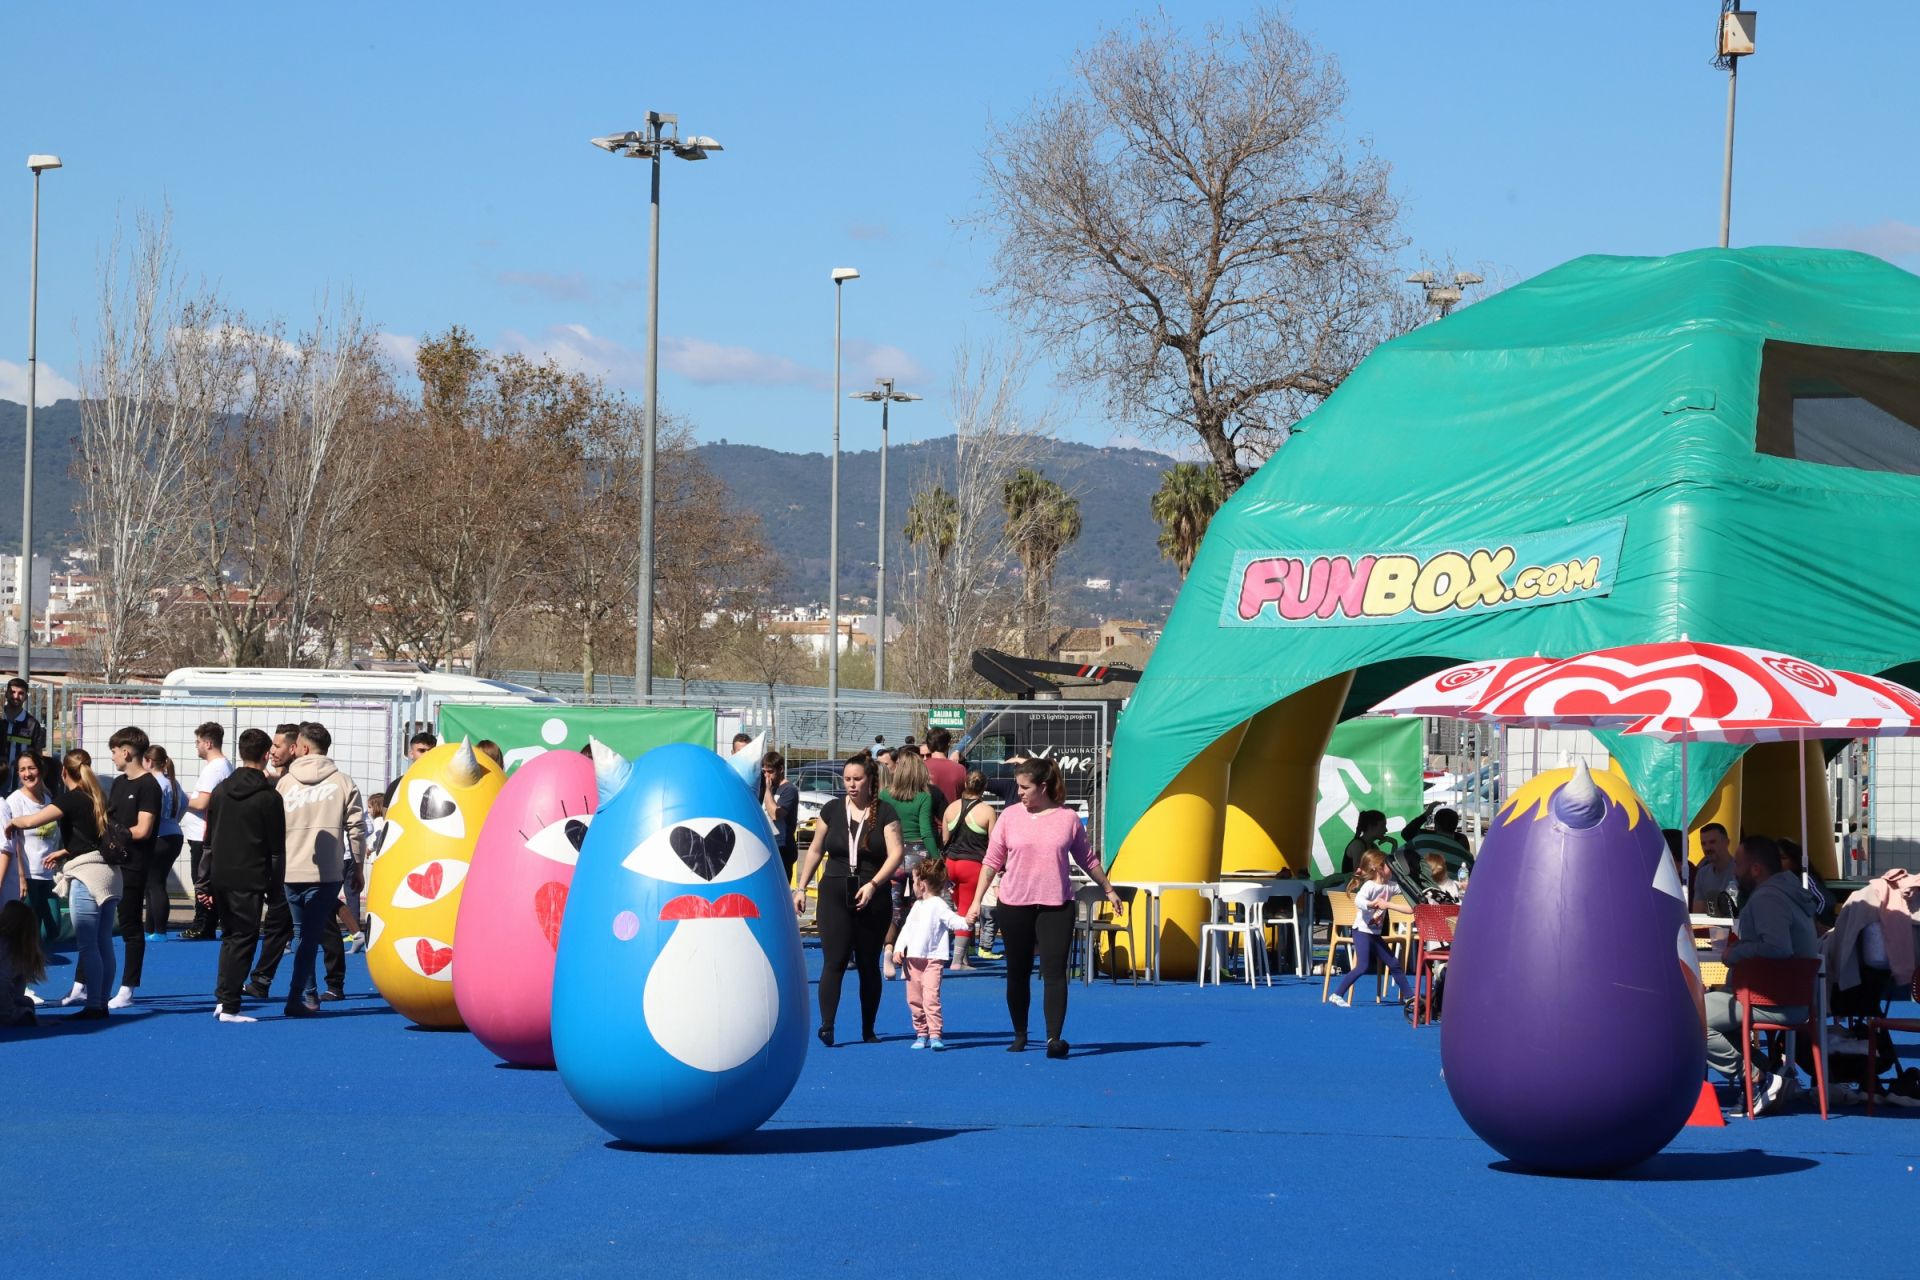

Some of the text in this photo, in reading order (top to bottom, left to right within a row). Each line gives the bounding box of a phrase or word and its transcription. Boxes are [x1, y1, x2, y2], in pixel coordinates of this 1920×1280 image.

[1238, 546, 1600, 620] FUNBOX.COM
[933, 710, 961, 718] SALIDA DE
[1047, 713, 1069, 721] lighting
[1070, 713, 1092, 721] projects
